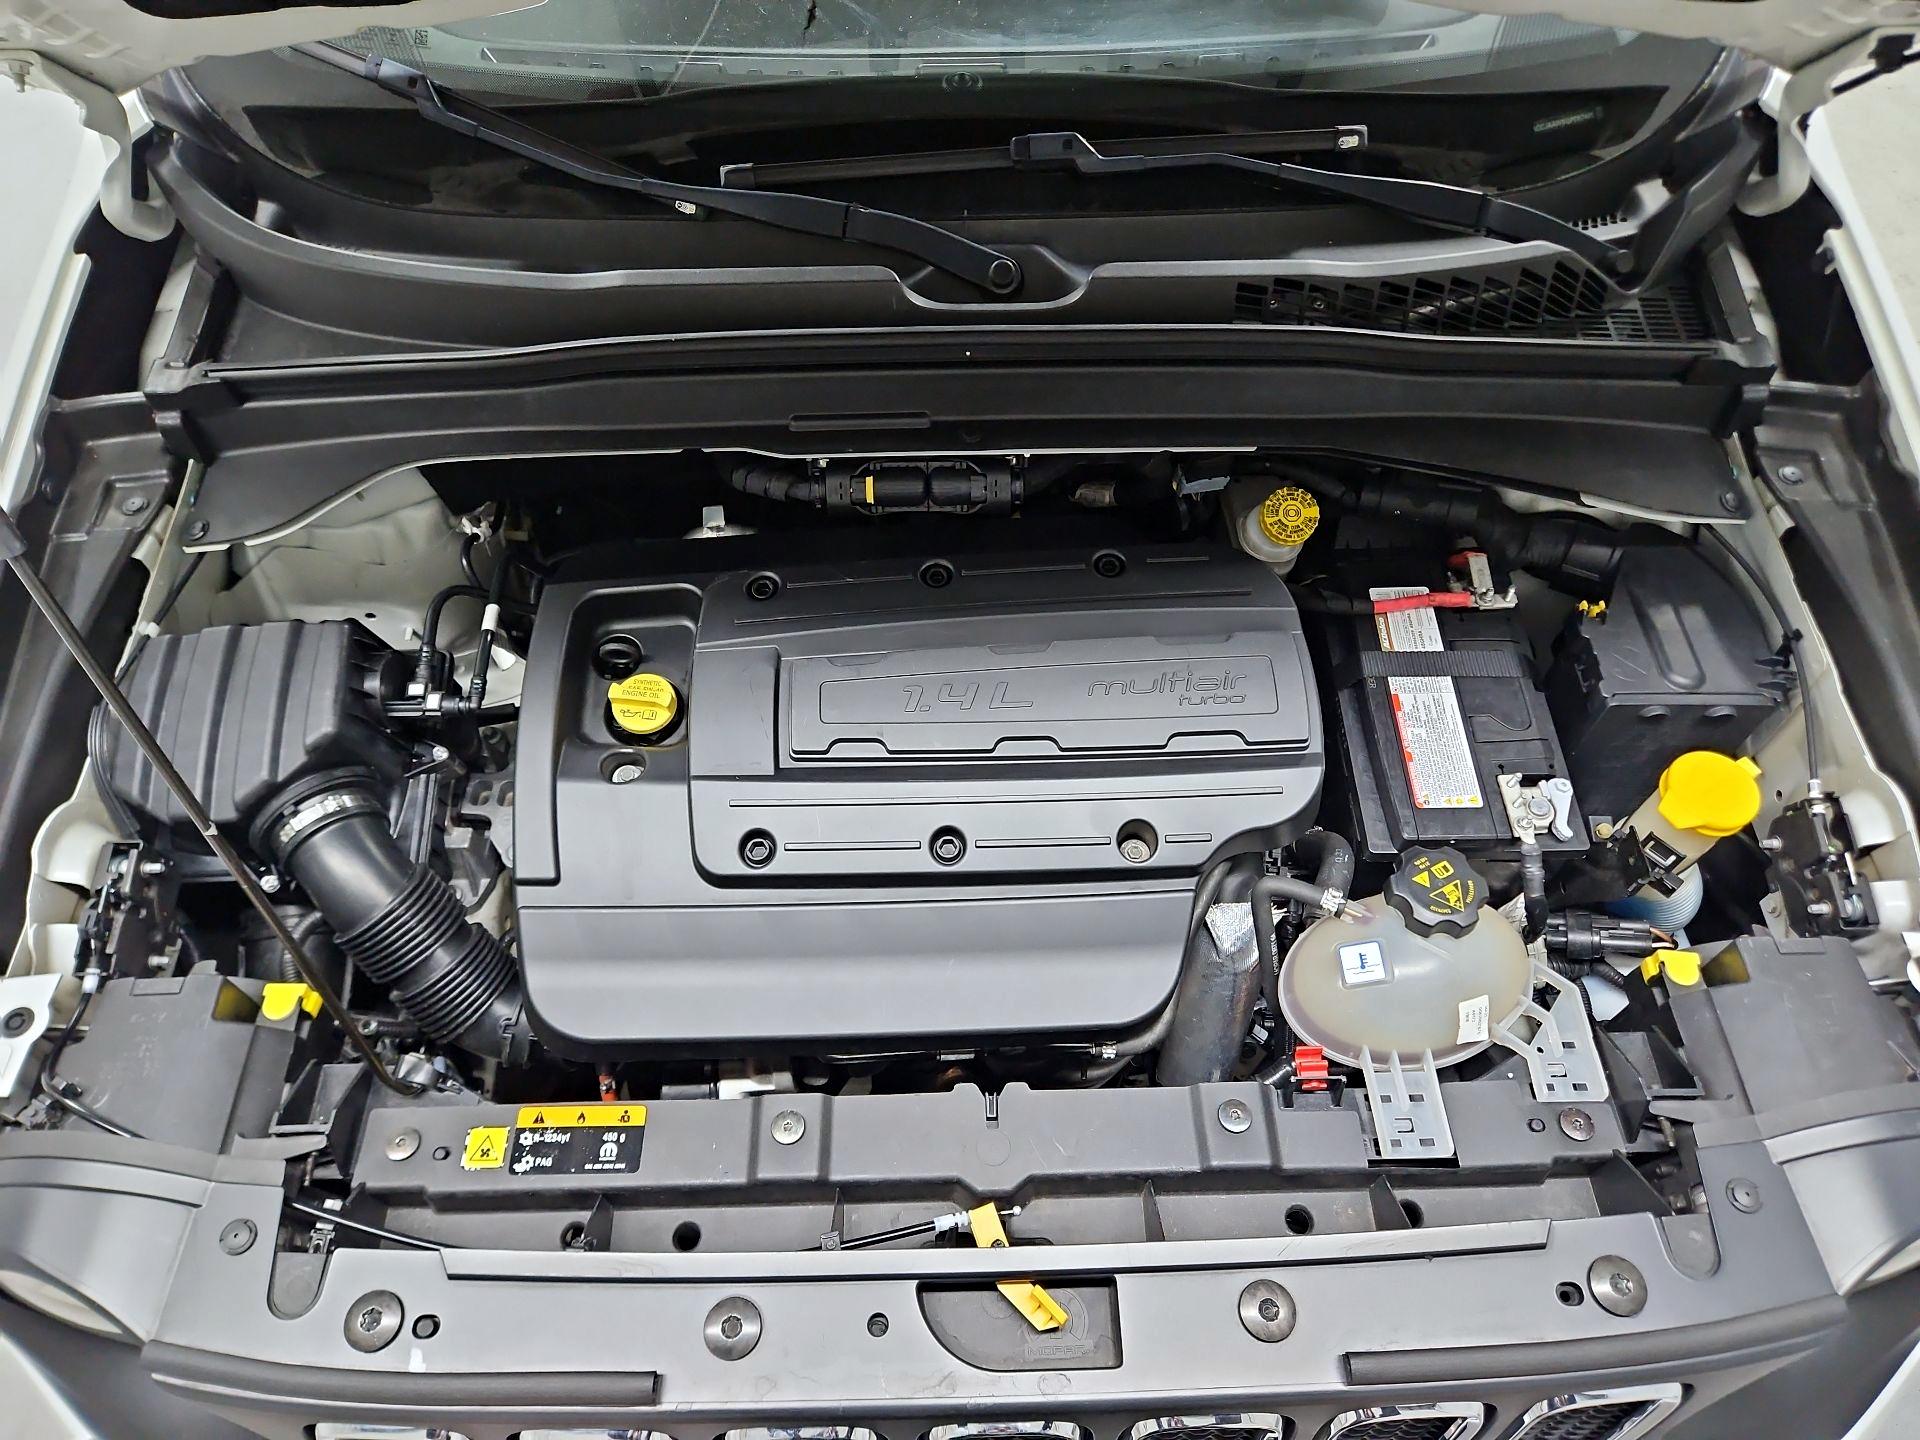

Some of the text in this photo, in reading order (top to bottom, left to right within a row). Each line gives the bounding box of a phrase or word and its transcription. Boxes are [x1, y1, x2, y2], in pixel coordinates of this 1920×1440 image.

[1378, 617, 1391, 650] ACDelco
[633, 678, 662, 687] SYNTHETIC
[1088, 669, 1248, 697] multiair
[621, 689, 661, 699] ENGINE OIL
[902, 681, 1034, 713] 1.4 L
[1178, 694, 1247, 706] turbo
[533, 1132, 572, 1144] R-1234yf
[535, 1156, 553, 1167] PAG
